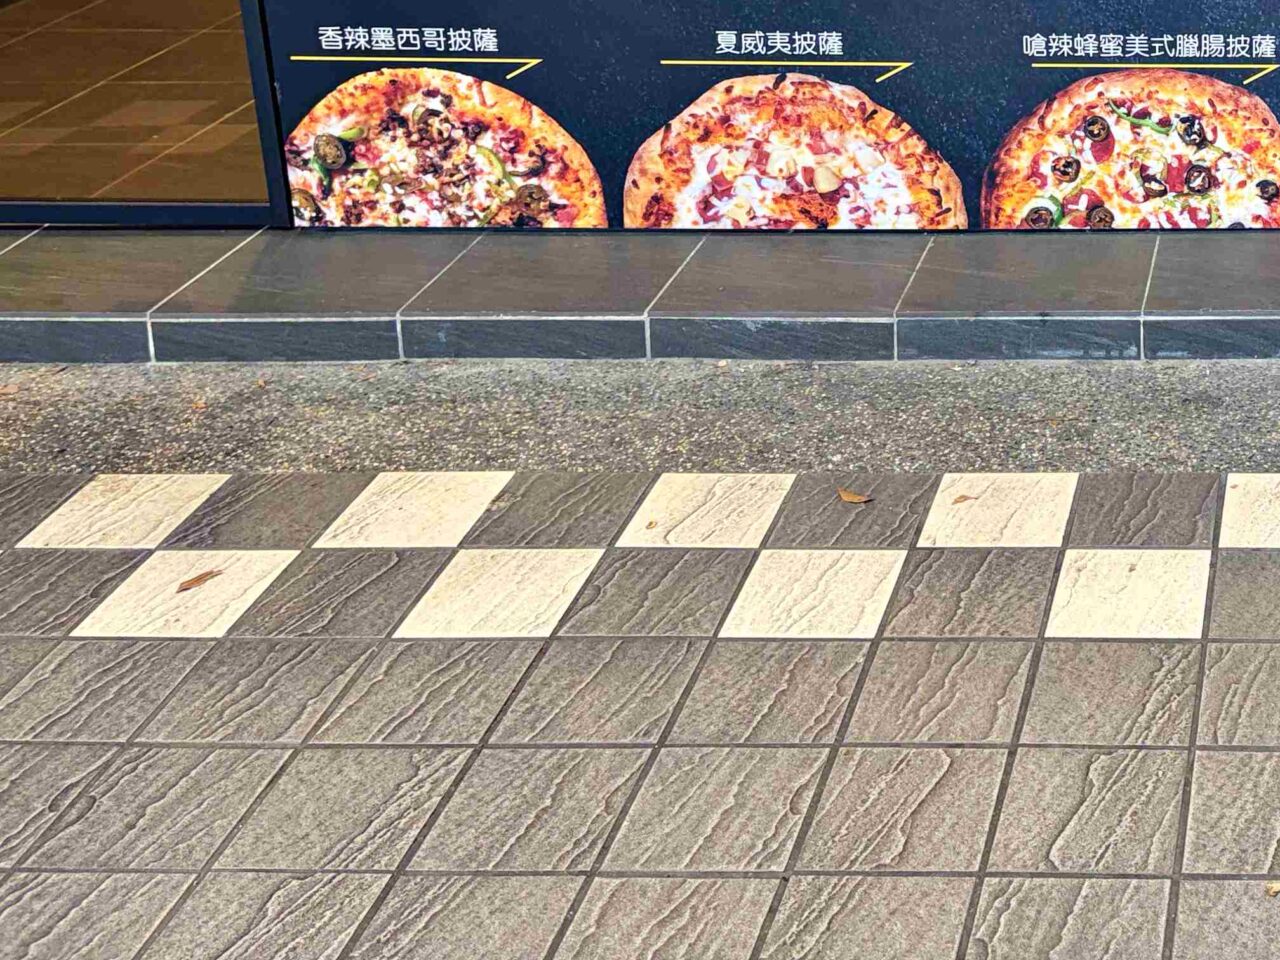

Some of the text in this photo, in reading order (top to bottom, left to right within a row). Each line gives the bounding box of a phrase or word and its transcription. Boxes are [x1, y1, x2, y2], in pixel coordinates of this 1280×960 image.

[318, 26, 500, 52] 香辣墨西哥披薩
[715, 30, 844, 56] 夏威夷披薩
[1022, 33, 1277, 59] 嗆辣蜂蜜美式臘腸披薩
